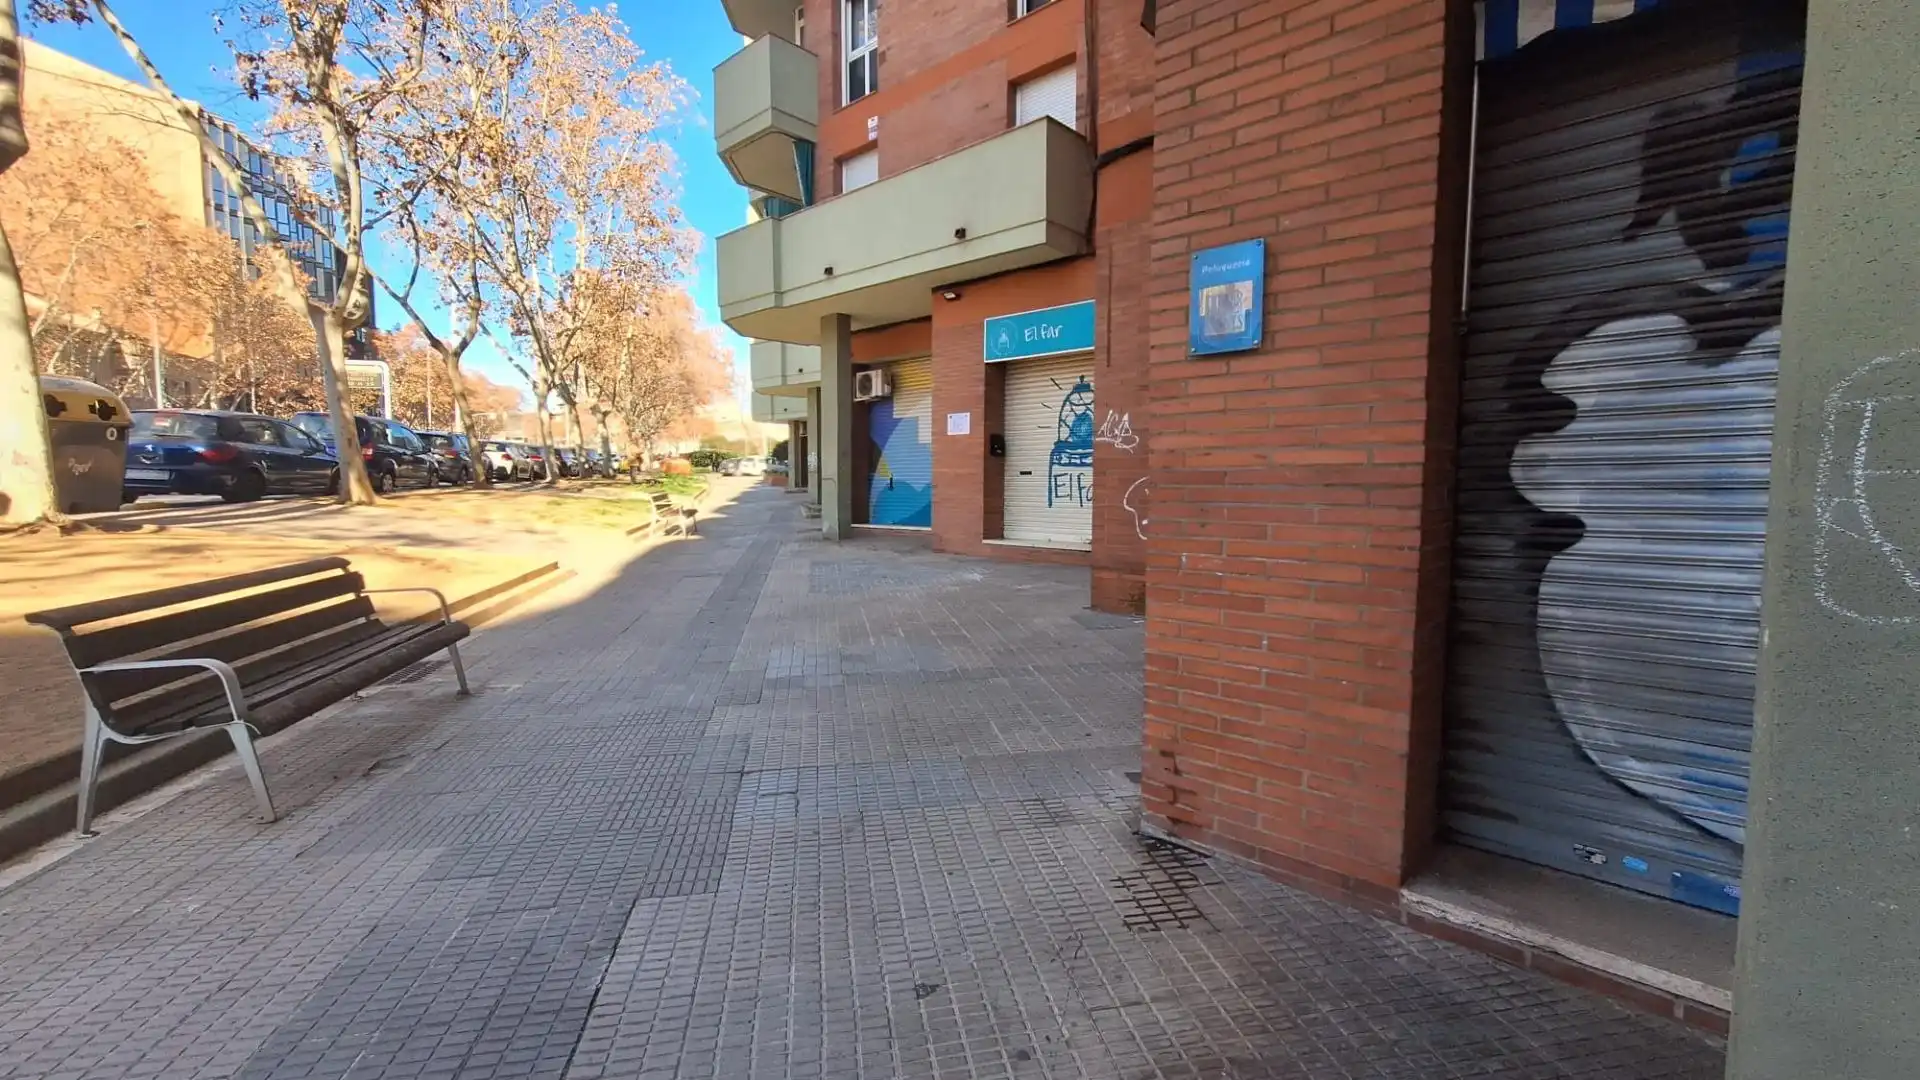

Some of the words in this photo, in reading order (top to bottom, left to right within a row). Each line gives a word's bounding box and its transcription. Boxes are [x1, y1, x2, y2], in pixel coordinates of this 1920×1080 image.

[1024, 326, 1038, 342] El
[1041, 323, 1064, 339] far
[1053, 472, 1073, 501] El
